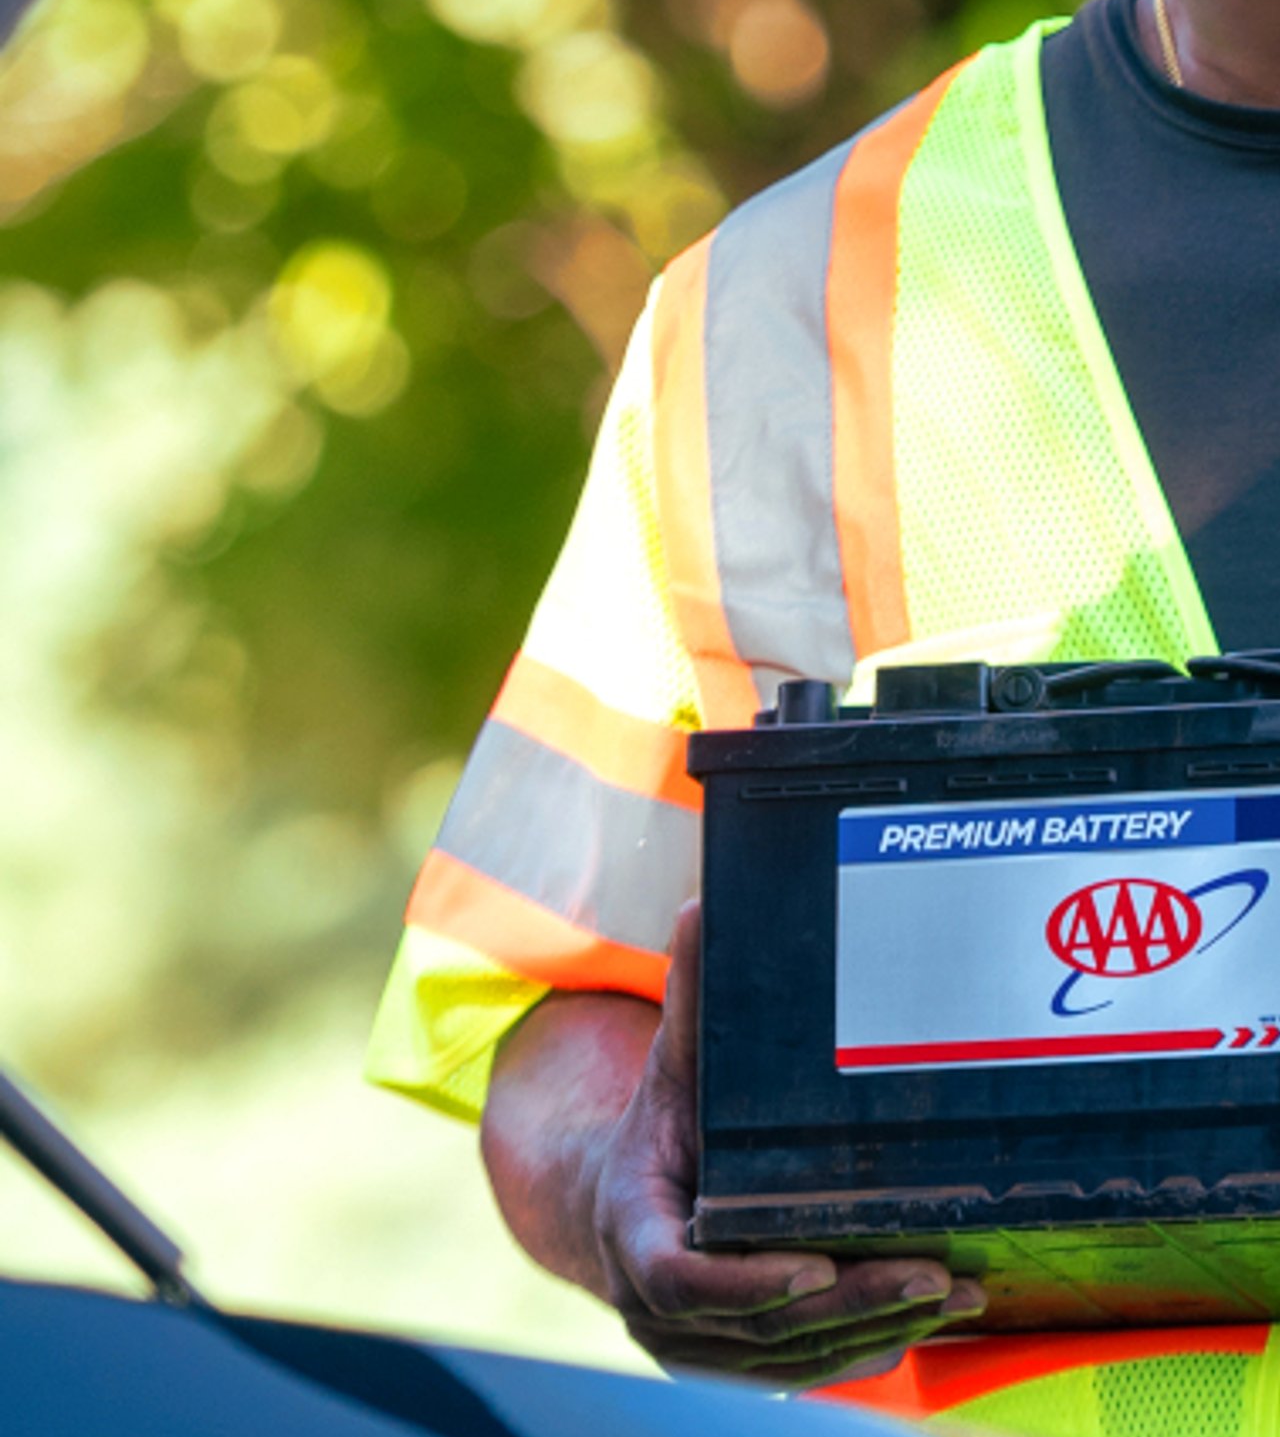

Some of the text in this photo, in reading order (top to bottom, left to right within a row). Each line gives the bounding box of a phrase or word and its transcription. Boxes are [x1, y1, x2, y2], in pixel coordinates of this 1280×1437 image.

[879, 810, 1193, 853] PREMIUM BATTERY
[1049, 879, 1199, 976] AAA
